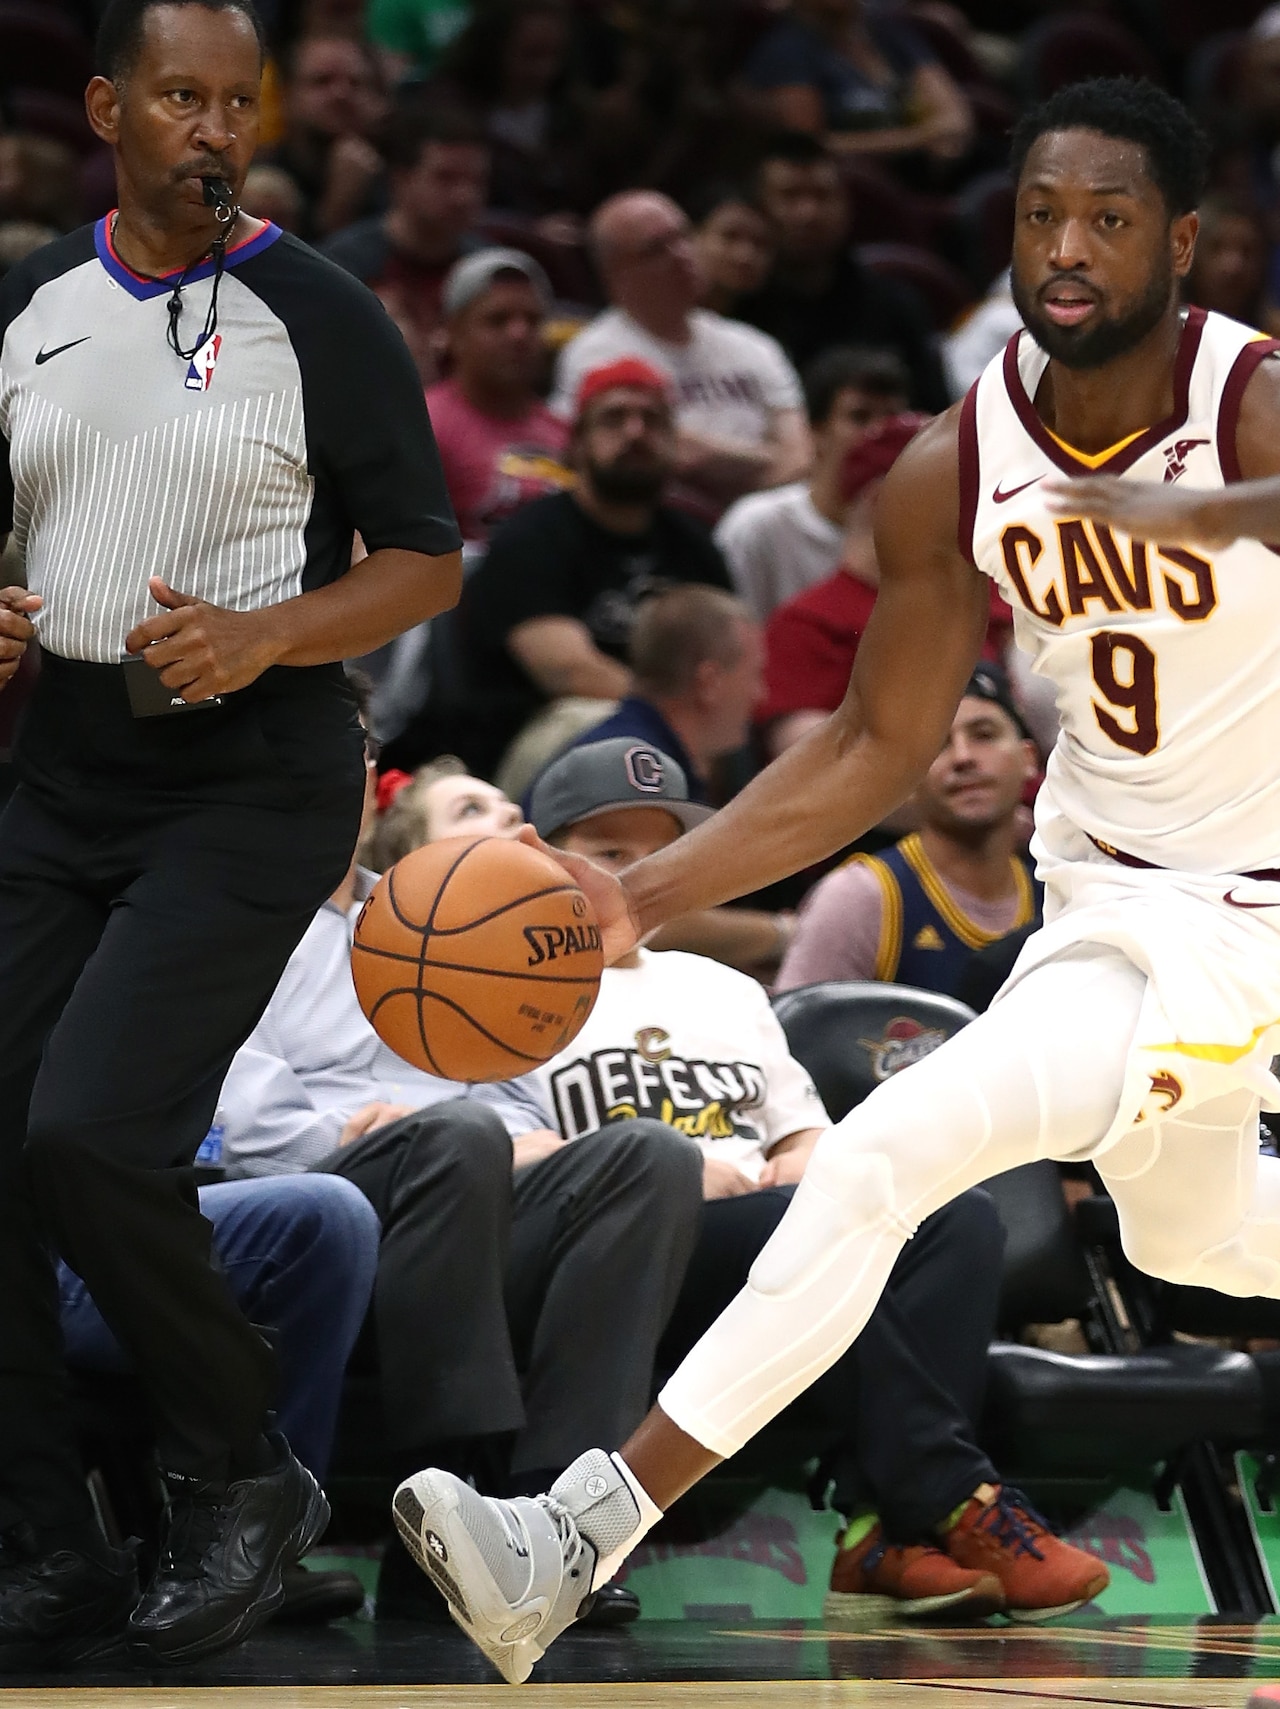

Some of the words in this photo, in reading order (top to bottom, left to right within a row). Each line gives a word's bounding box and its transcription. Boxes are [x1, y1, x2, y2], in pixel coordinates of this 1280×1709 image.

[1000, 516, 1220, 629] CAVS
[1089, 629, 1161, 756] 9
[624, 746, 663, 793] C
[551, 1048, 767, 1140] DEFEND
